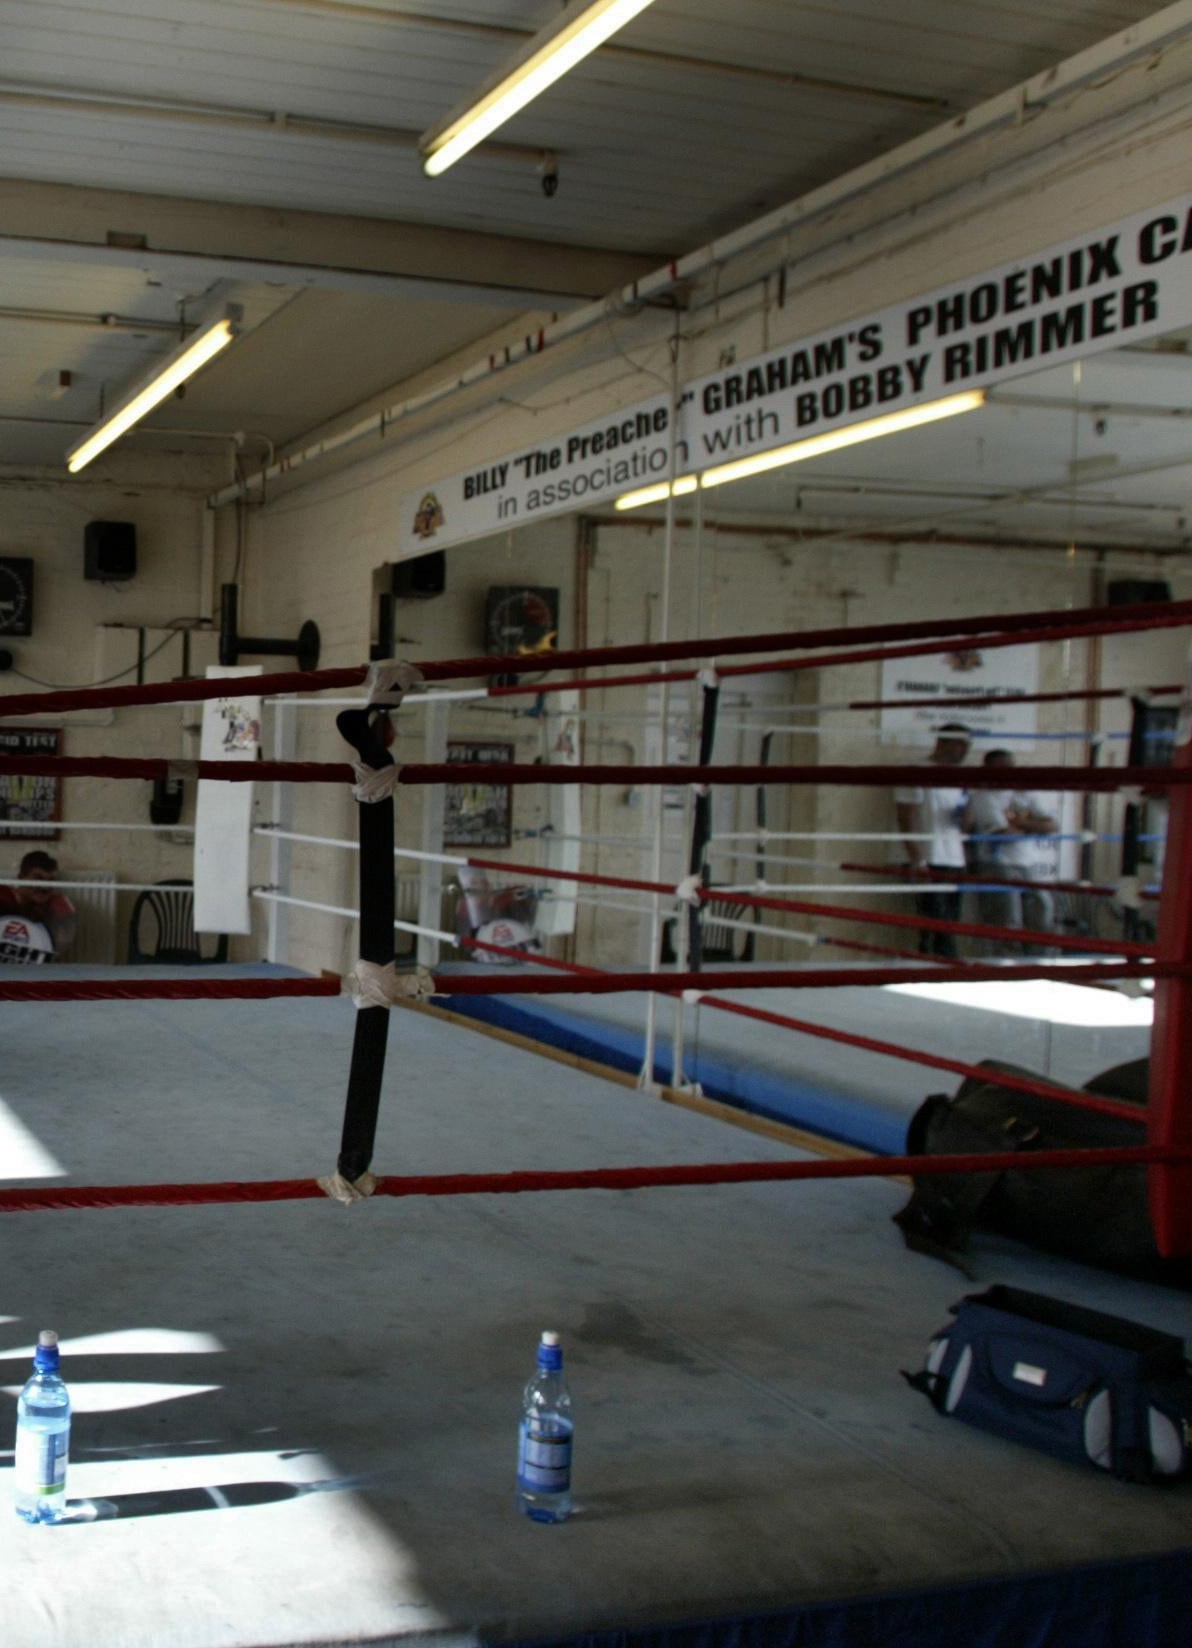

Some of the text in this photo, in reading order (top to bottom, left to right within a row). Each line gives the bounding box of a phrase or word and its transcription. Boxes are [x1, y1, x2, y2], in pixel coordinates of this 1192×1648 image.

[463, 461, 509, 500] BILLY
[703, 323, 883, 415] GRAHAM'S
[905, 233, 1122, 347] PHOENIX
[497, 279, 1159, 519] in association with BOBBY RIMMER
[25, 735, 57, 747] TEST
